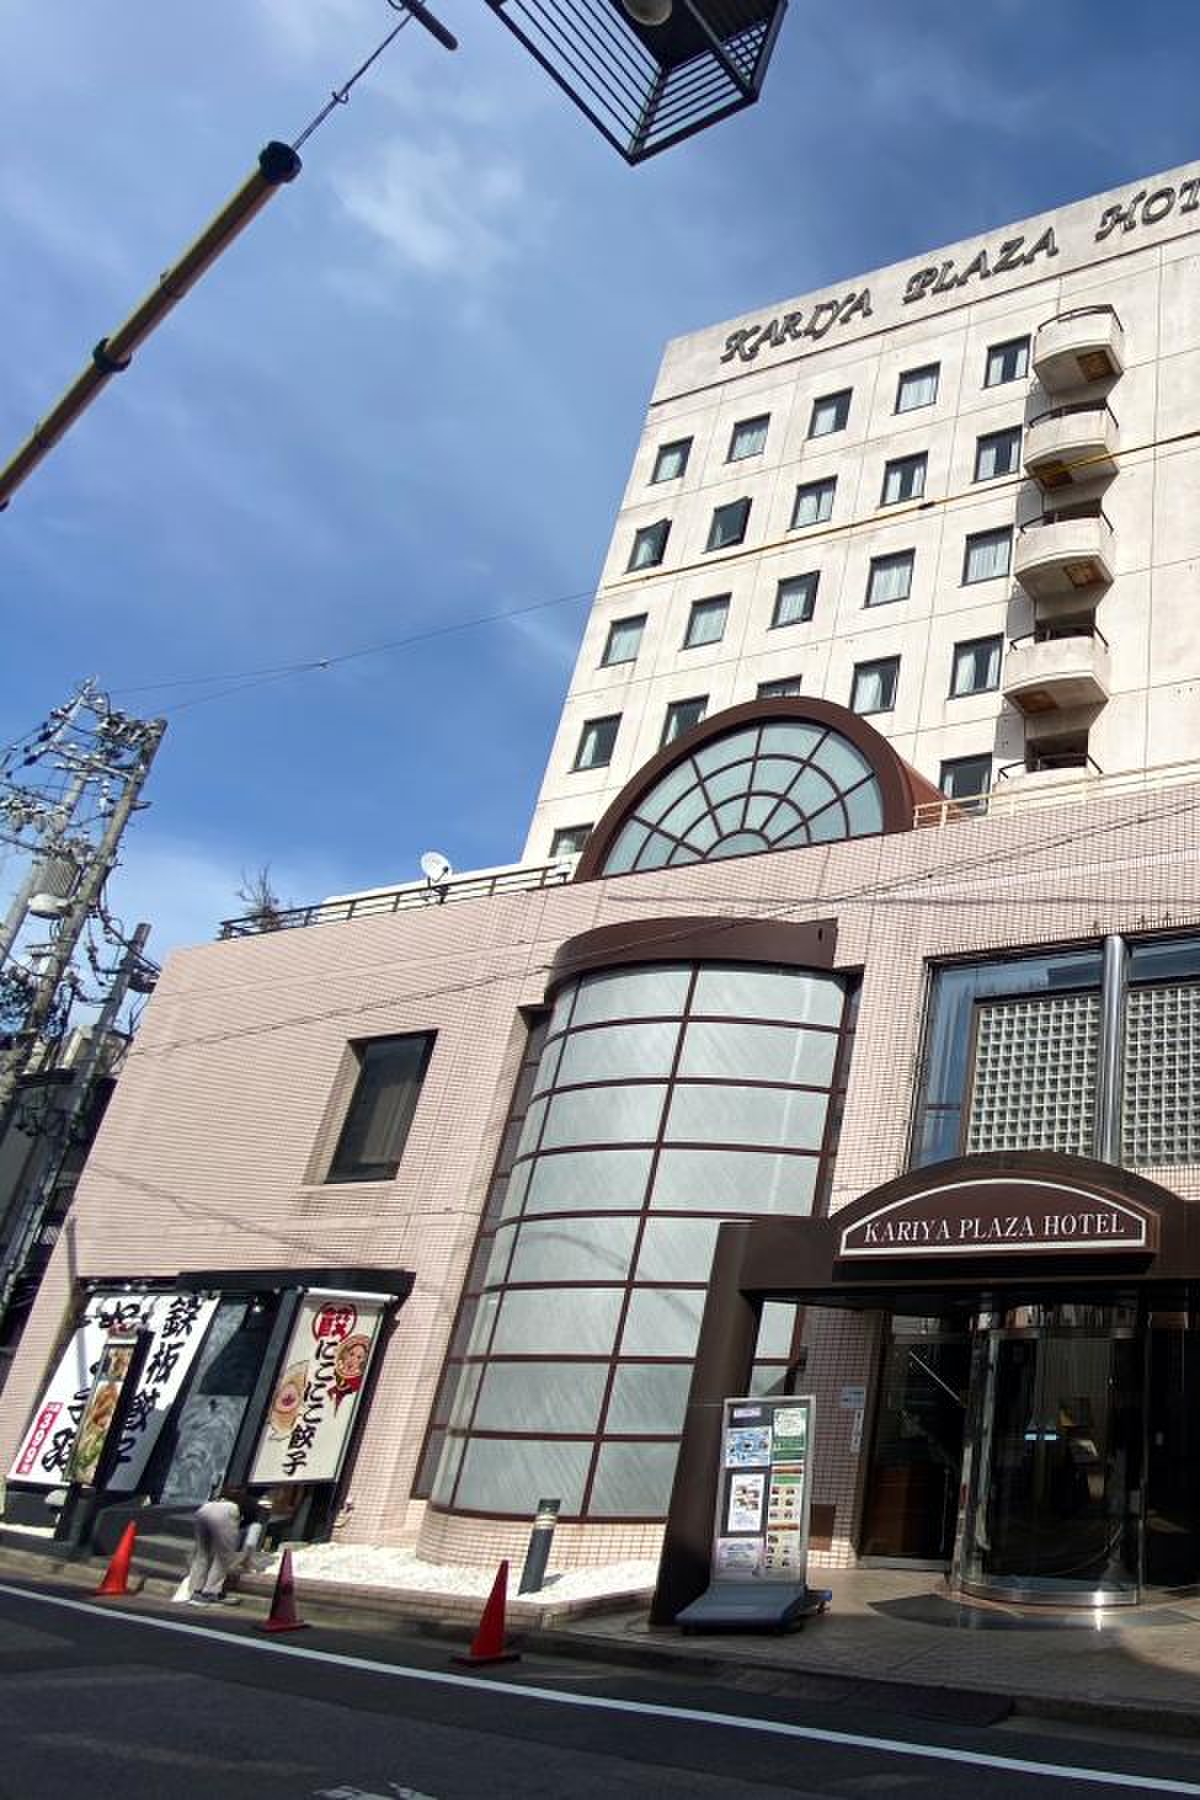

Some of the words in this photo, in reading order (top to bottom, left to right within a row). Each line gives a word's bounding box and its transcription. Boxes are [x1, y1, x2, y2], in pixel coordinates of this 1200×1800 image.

[720, 287, 873, 365] KARIYA
[902, 226, 1059, 304] PLAZA
[863, 1218, 951, 1244] KARIYA
[959, 1216, 1035, 1240] PLAZA
[1044, 1213, 1125, 1237] HOTEL
[281, 1339, 339, 1476] にこにこ餃子
